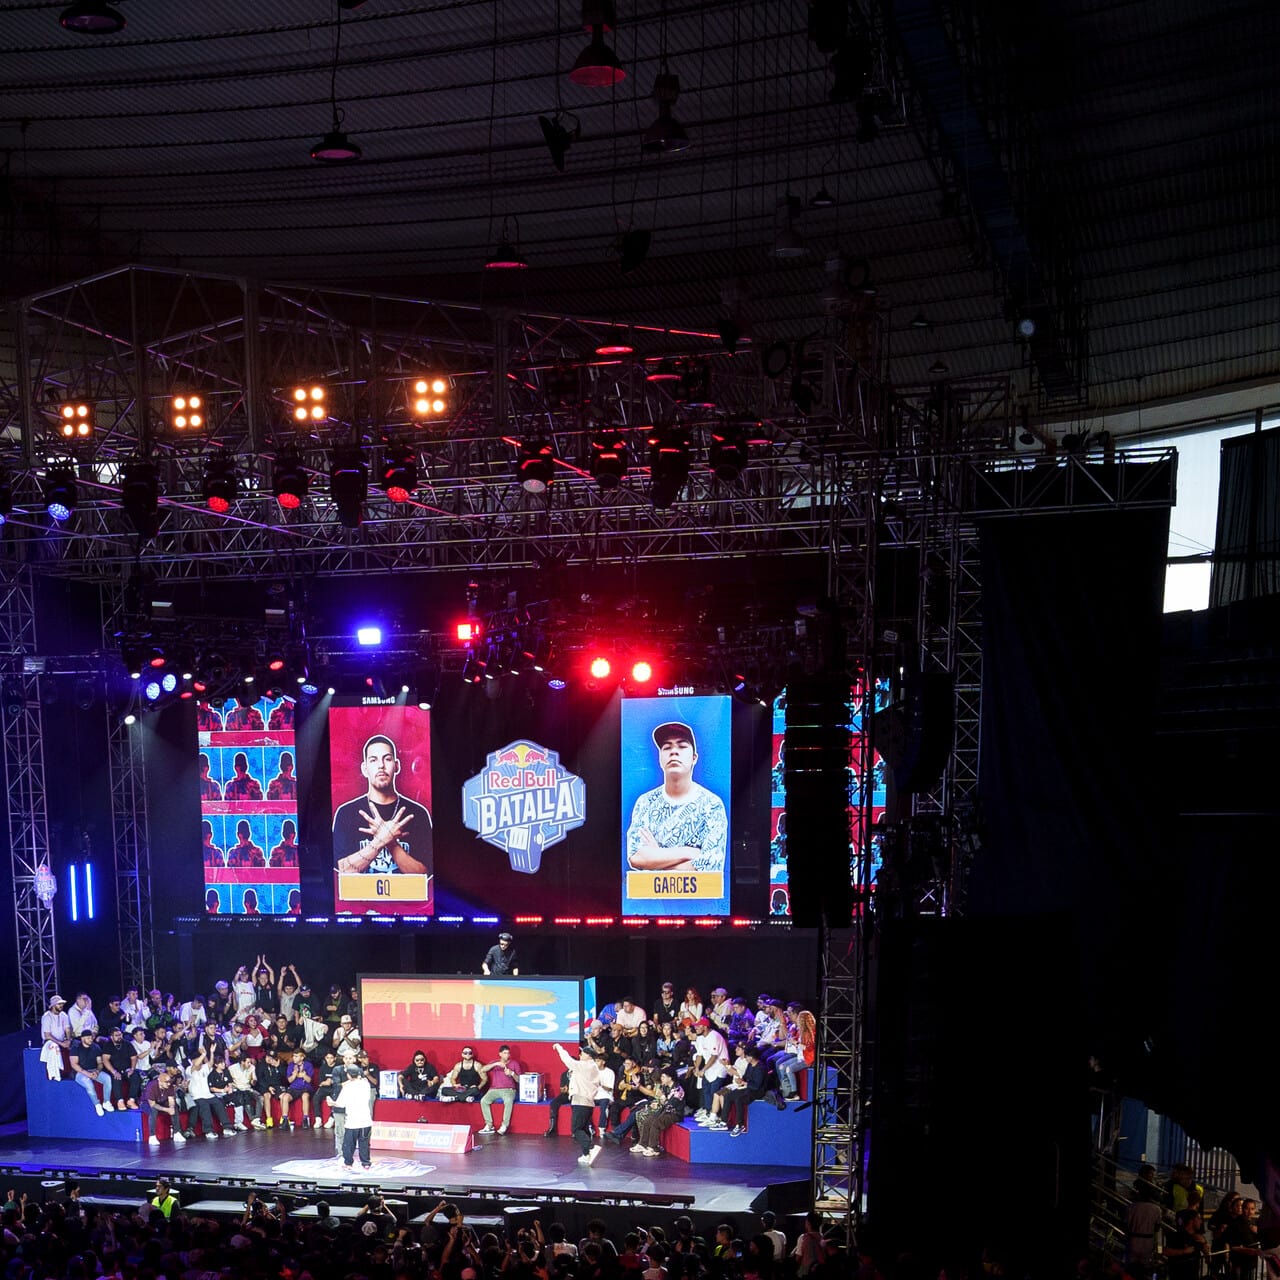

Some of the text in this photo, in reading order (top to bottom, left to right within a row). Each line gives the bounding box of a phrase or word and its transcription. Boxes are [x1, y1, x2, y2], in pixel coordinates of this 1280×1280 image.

[489, 769, 556, 788] Red Bull
[481, 781, 574, 835] BATALLA
[376, 879, 391, 896] GQ
[653, 876, 697, 894] GARCES
